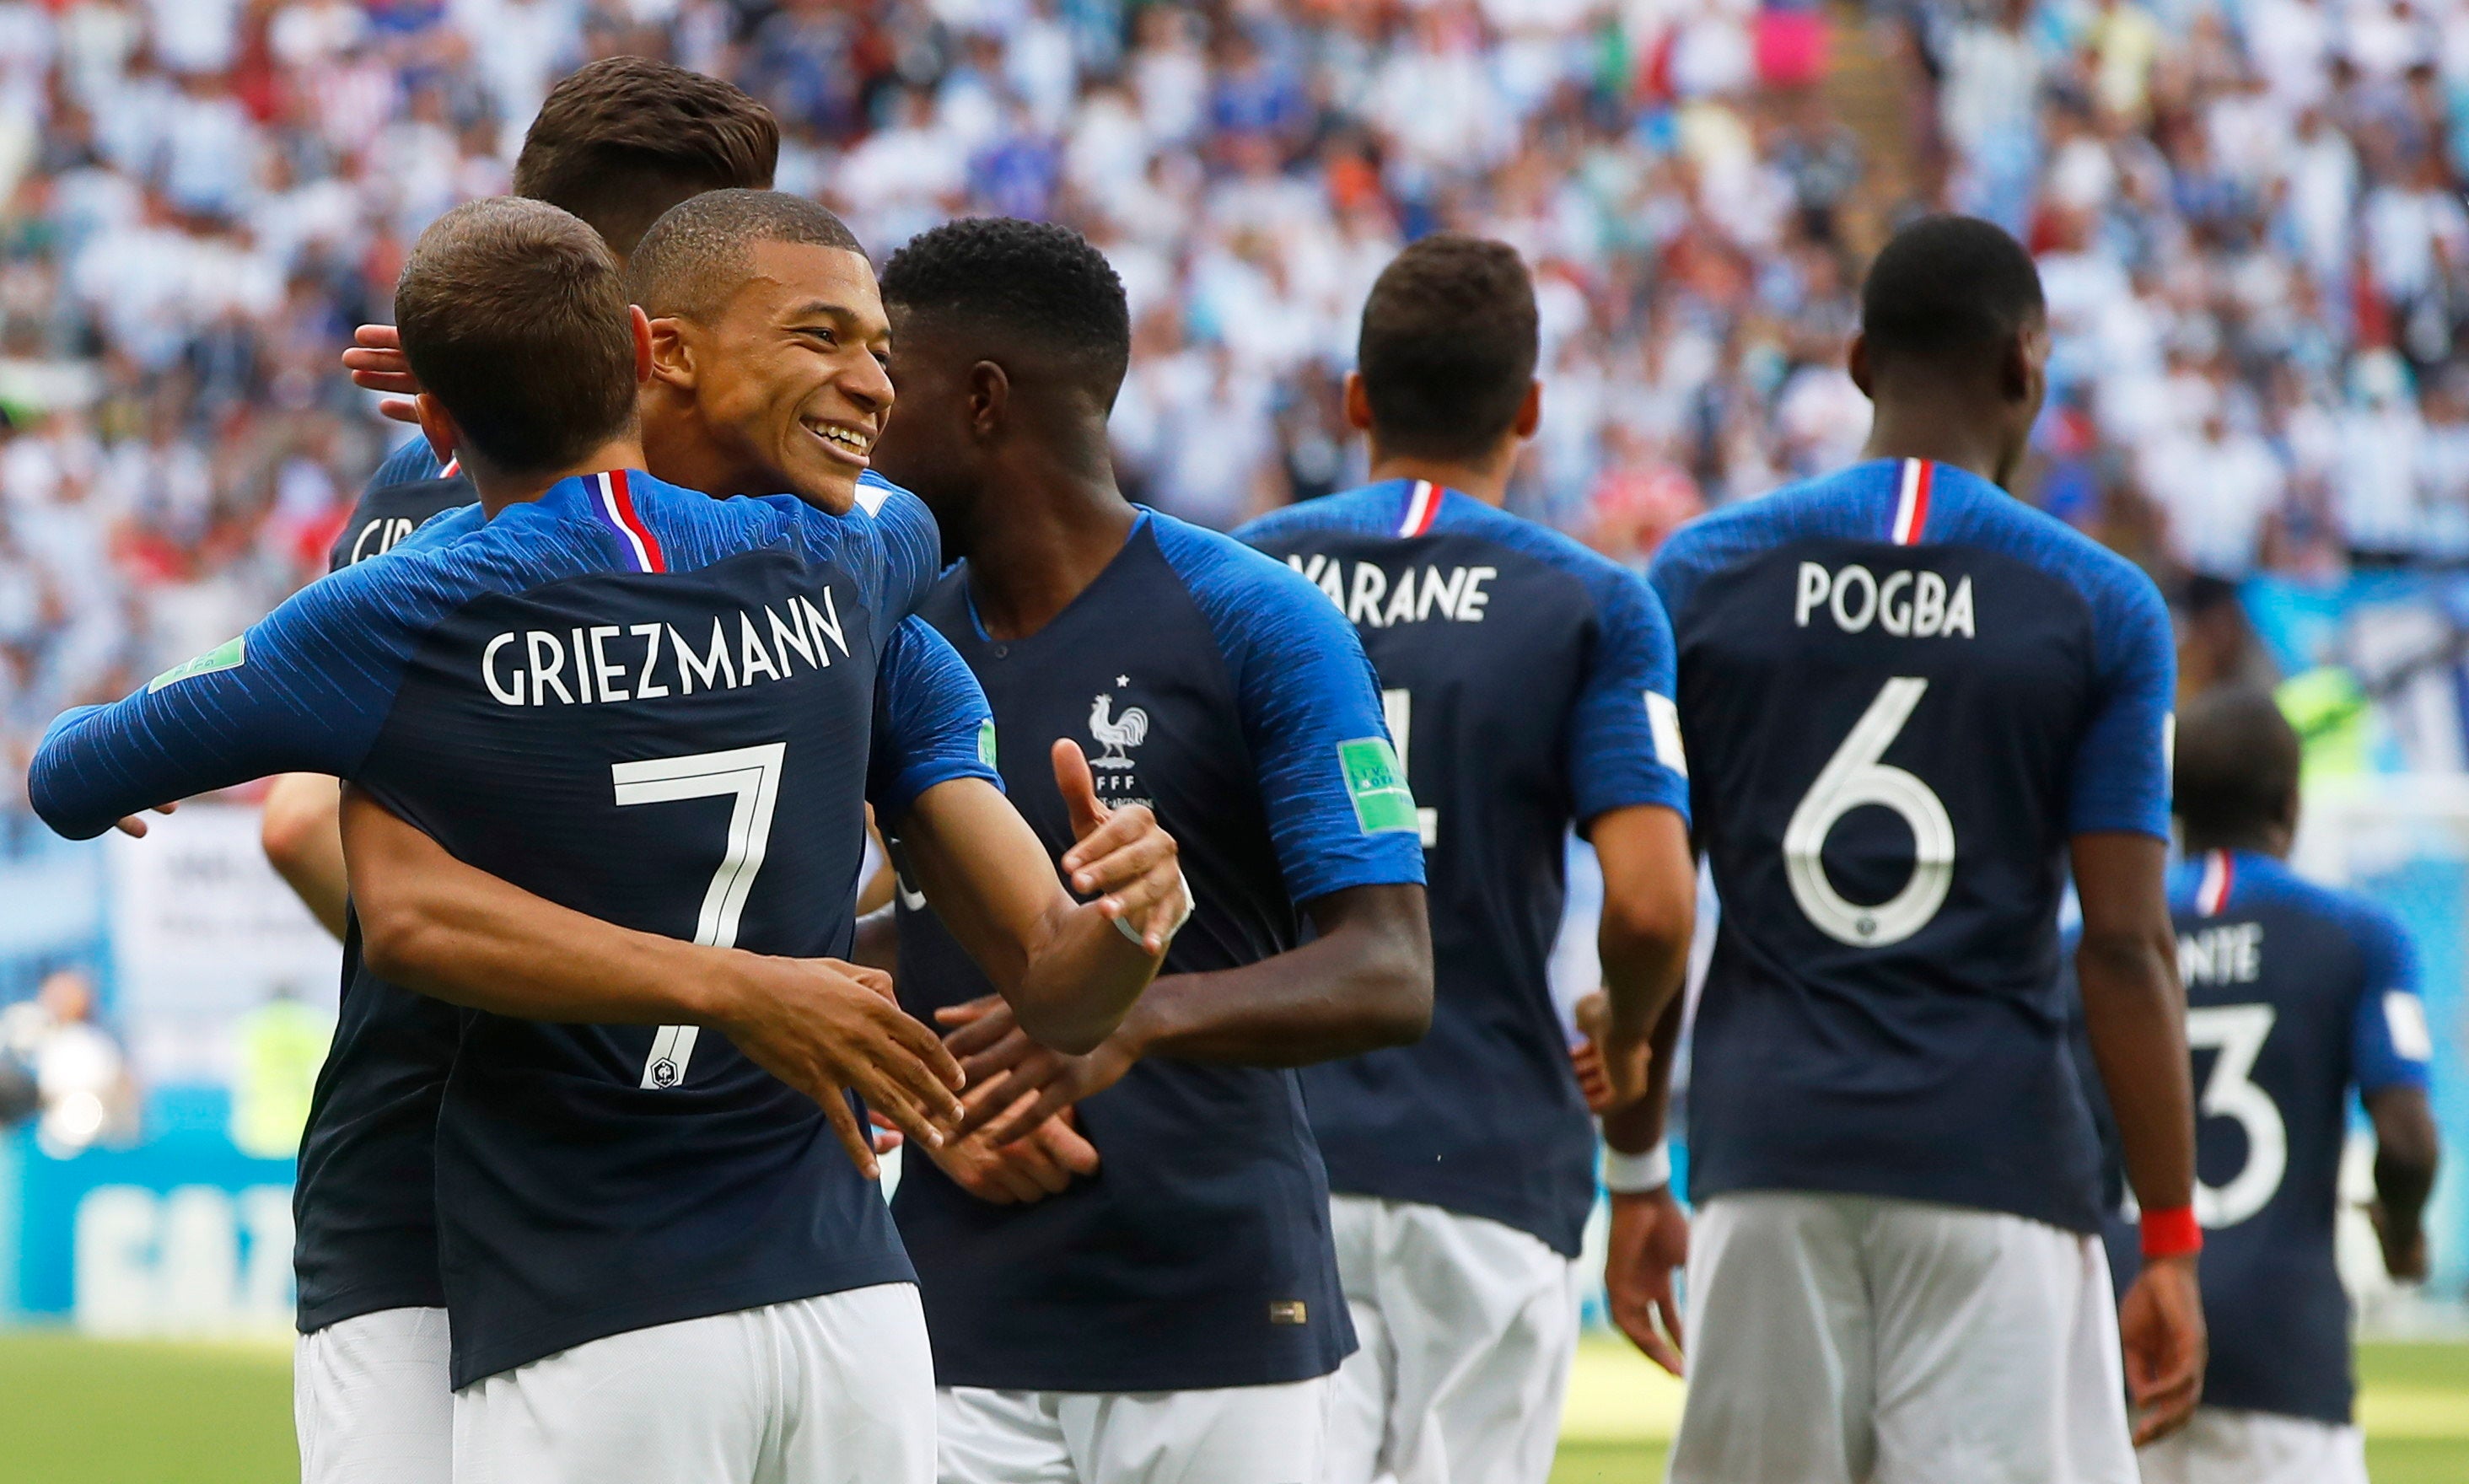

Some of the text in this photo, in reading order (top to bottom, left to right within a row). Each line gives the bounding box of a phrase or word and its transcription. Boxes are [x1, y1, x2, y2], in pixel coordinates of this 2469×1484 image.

[481, 585, 850, 707] GRIEZMANN
[1794, 561, 1975, 639] POGBA
[1096, 775, 1135, 791] FFF
[1782, 675, 1955, 949] 6
[611, 741, 787, 1090] 7
[2177, 922, 2265, 988] NTE
[2120, 1003, 2289, 1230] 3
